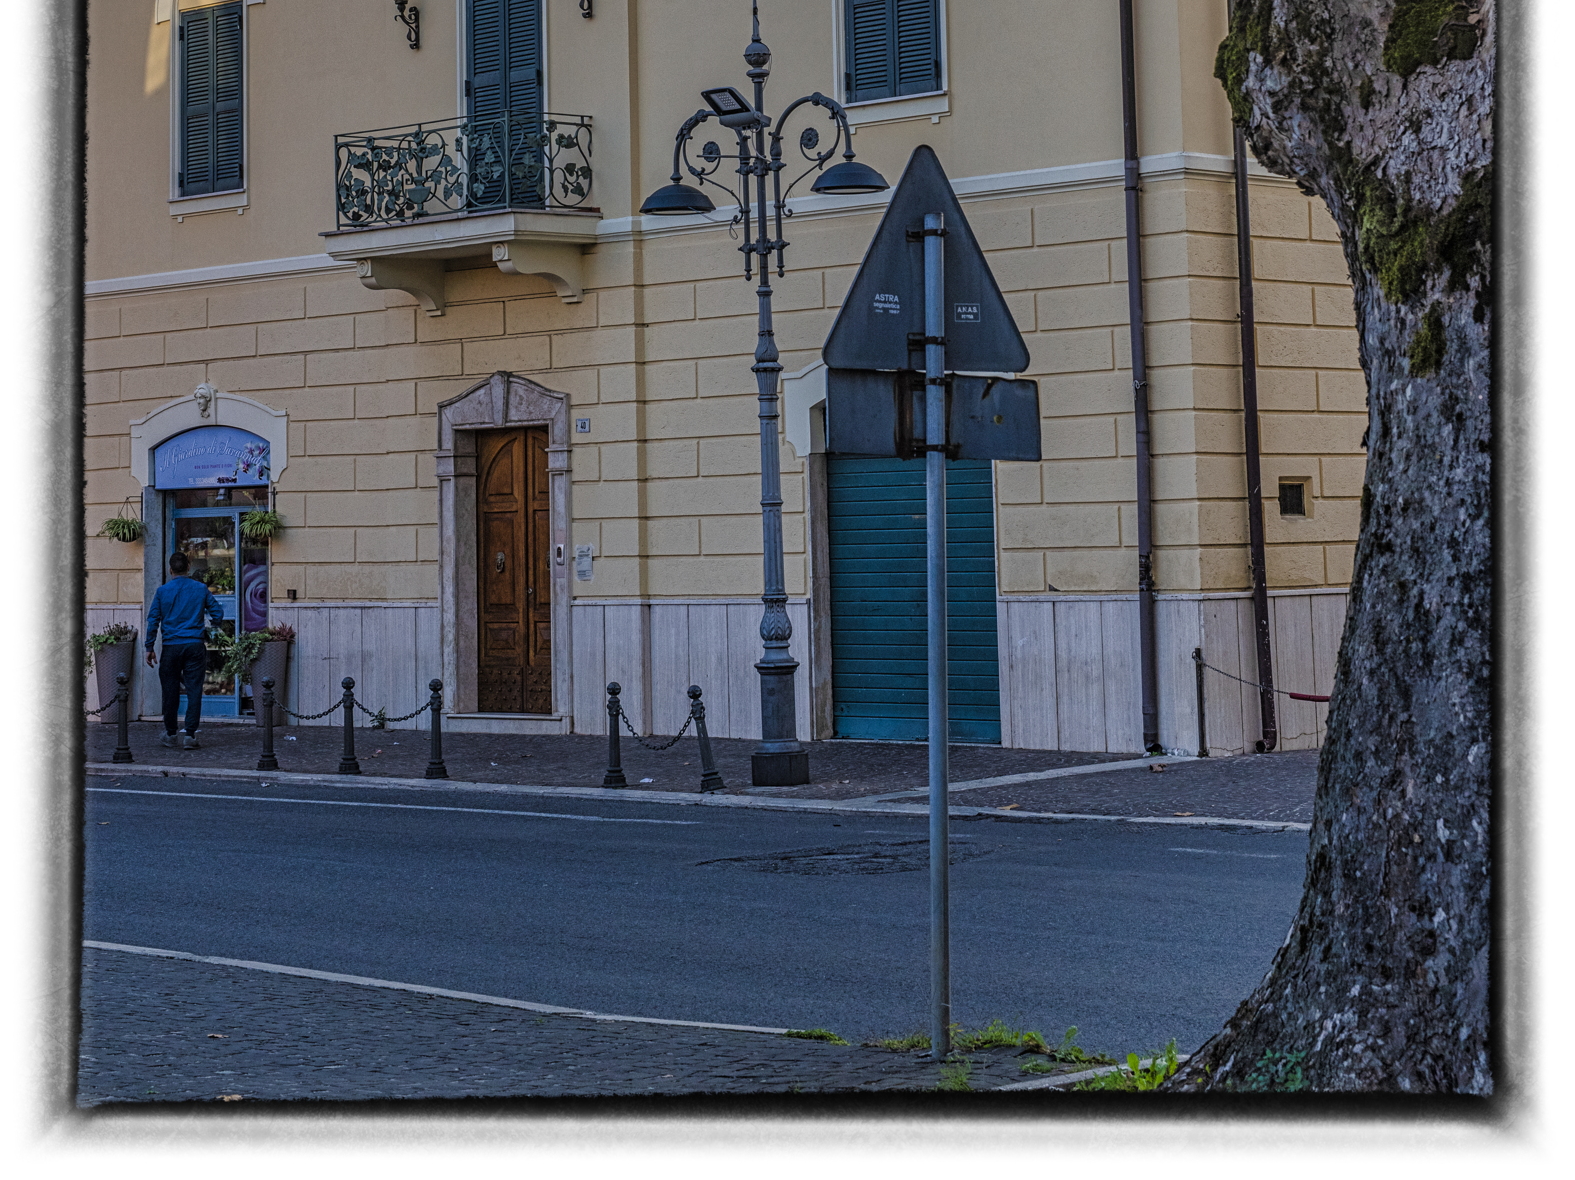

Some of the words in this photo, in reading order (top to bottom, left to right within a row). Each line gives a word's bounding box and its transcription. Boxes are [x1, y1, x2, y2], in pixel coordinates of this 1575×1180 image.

[874, 293, 899, 302] ASTRA
[171, 439, 206, 478] Giardino
[207, 437, 217, 454] di
